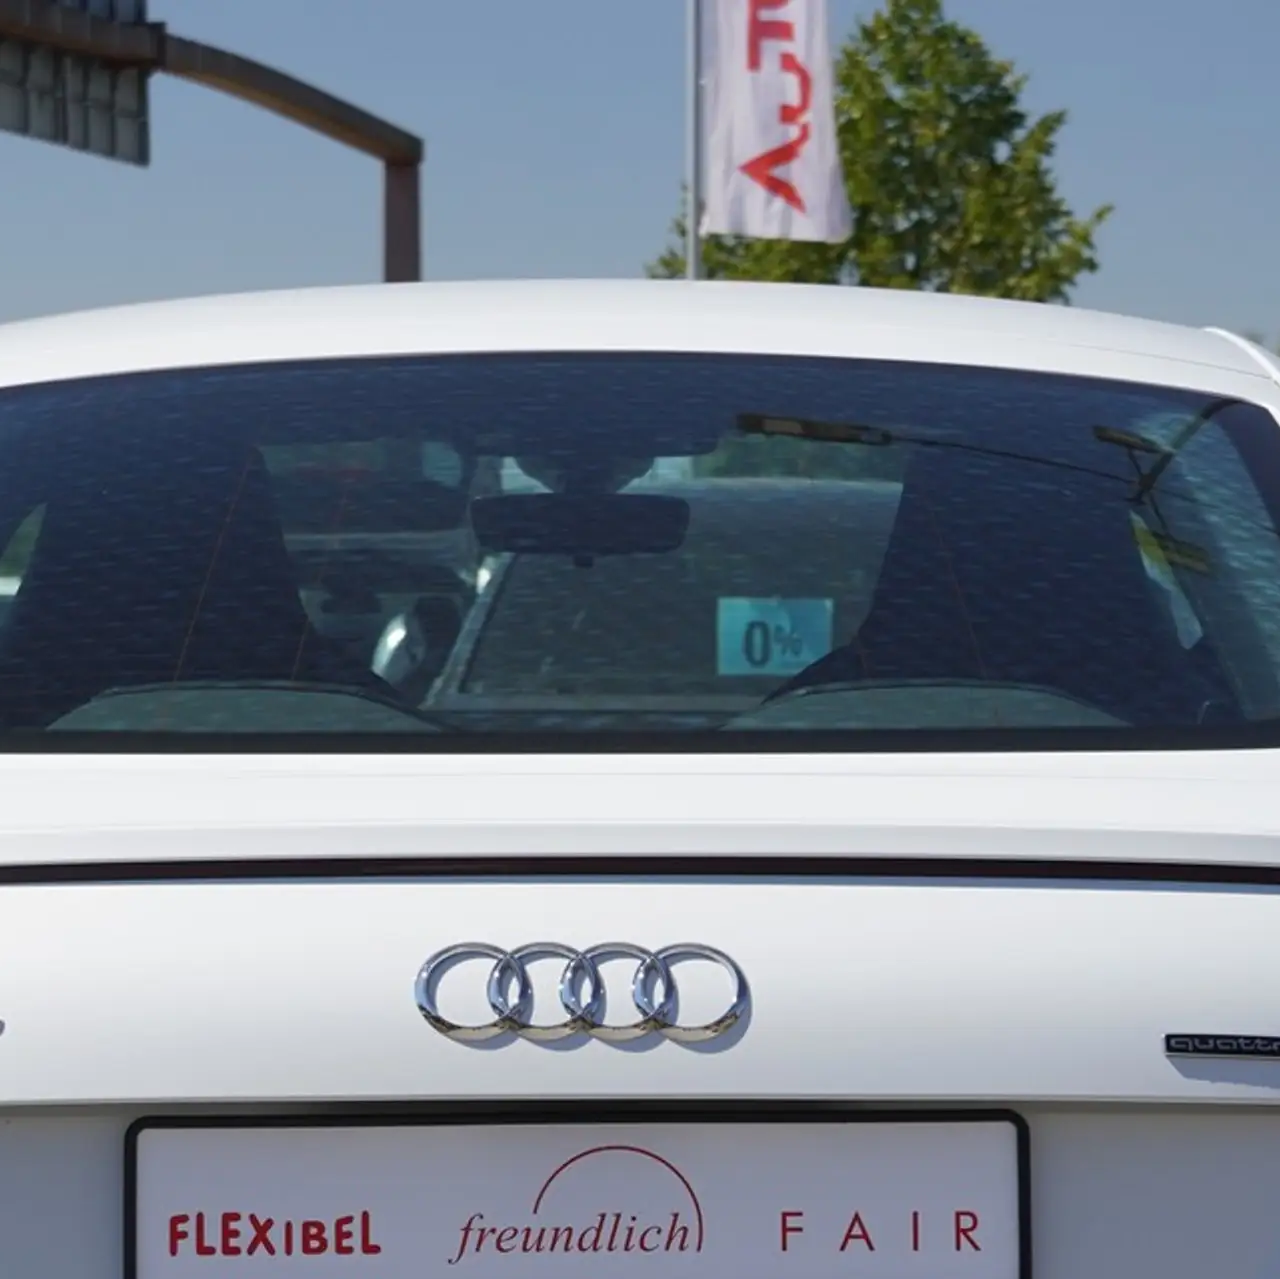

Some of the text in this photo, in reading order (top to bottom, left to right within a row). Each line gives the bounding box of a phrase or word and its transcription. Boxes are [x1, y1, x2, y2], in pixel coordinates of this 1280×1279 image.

[737, 0, 812, 214] AUT
[743, 620, 803, 668] 0%
[169, 1210, 982, 1265] FLEXIBEL freundlich FAIR
